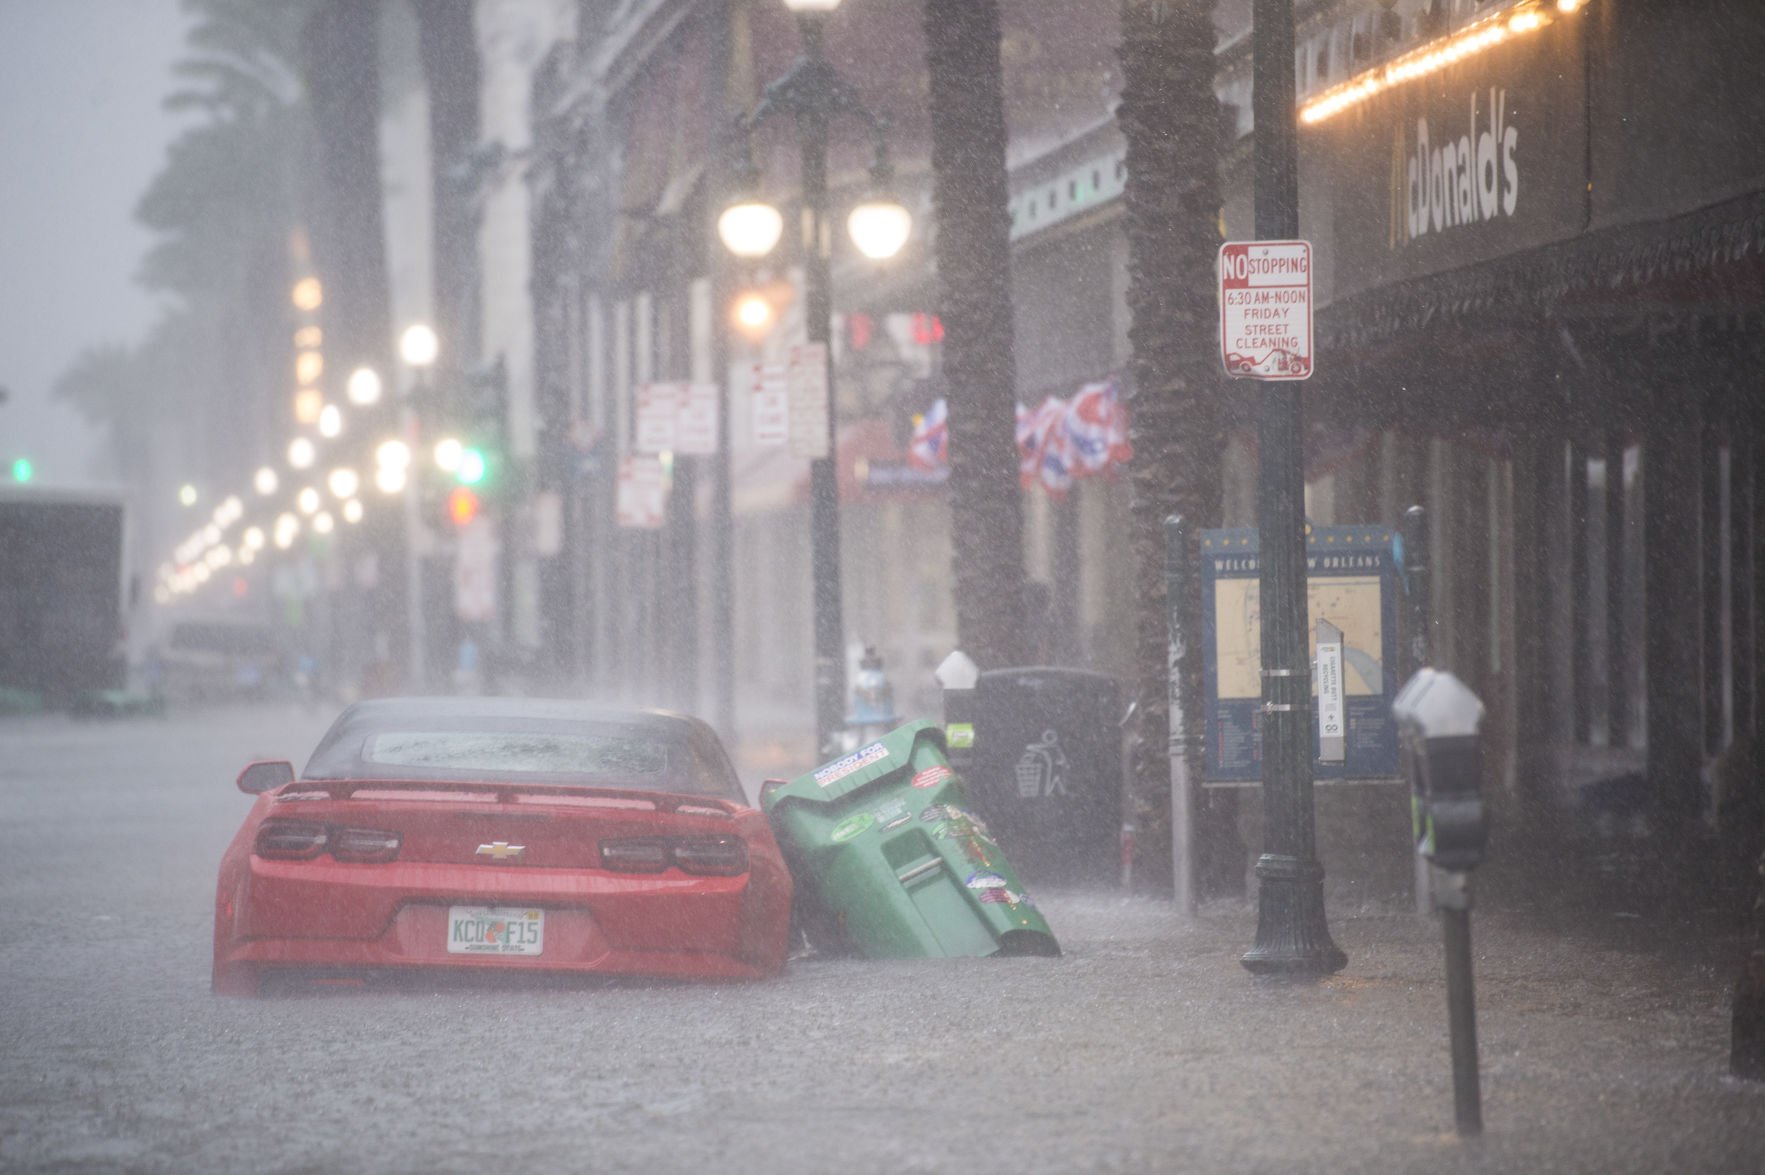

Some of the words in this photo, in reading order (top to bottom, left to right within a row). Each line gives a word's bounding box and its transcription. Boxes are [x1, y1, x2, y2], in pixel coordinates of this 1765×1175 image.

[1224, 254, 1247, 280] NO
[1248, 257, 1307, 274] STOPPING
[1228, 291, 1251, 305] 6:30
[1244, 308, 1290, 319] FRIDAY
[1244, 324, 1289, 335] STREET
[1236, 336, 1298, 349] CLEANING
[1214, 558, 1260, 571] WELCO
[1323, 555, 1381, 569] ORLEANS
[814, 753, 858, 780] NOBODY
[861, 743, 883, 757] FOR
[505, 922, 539, 944] F15
